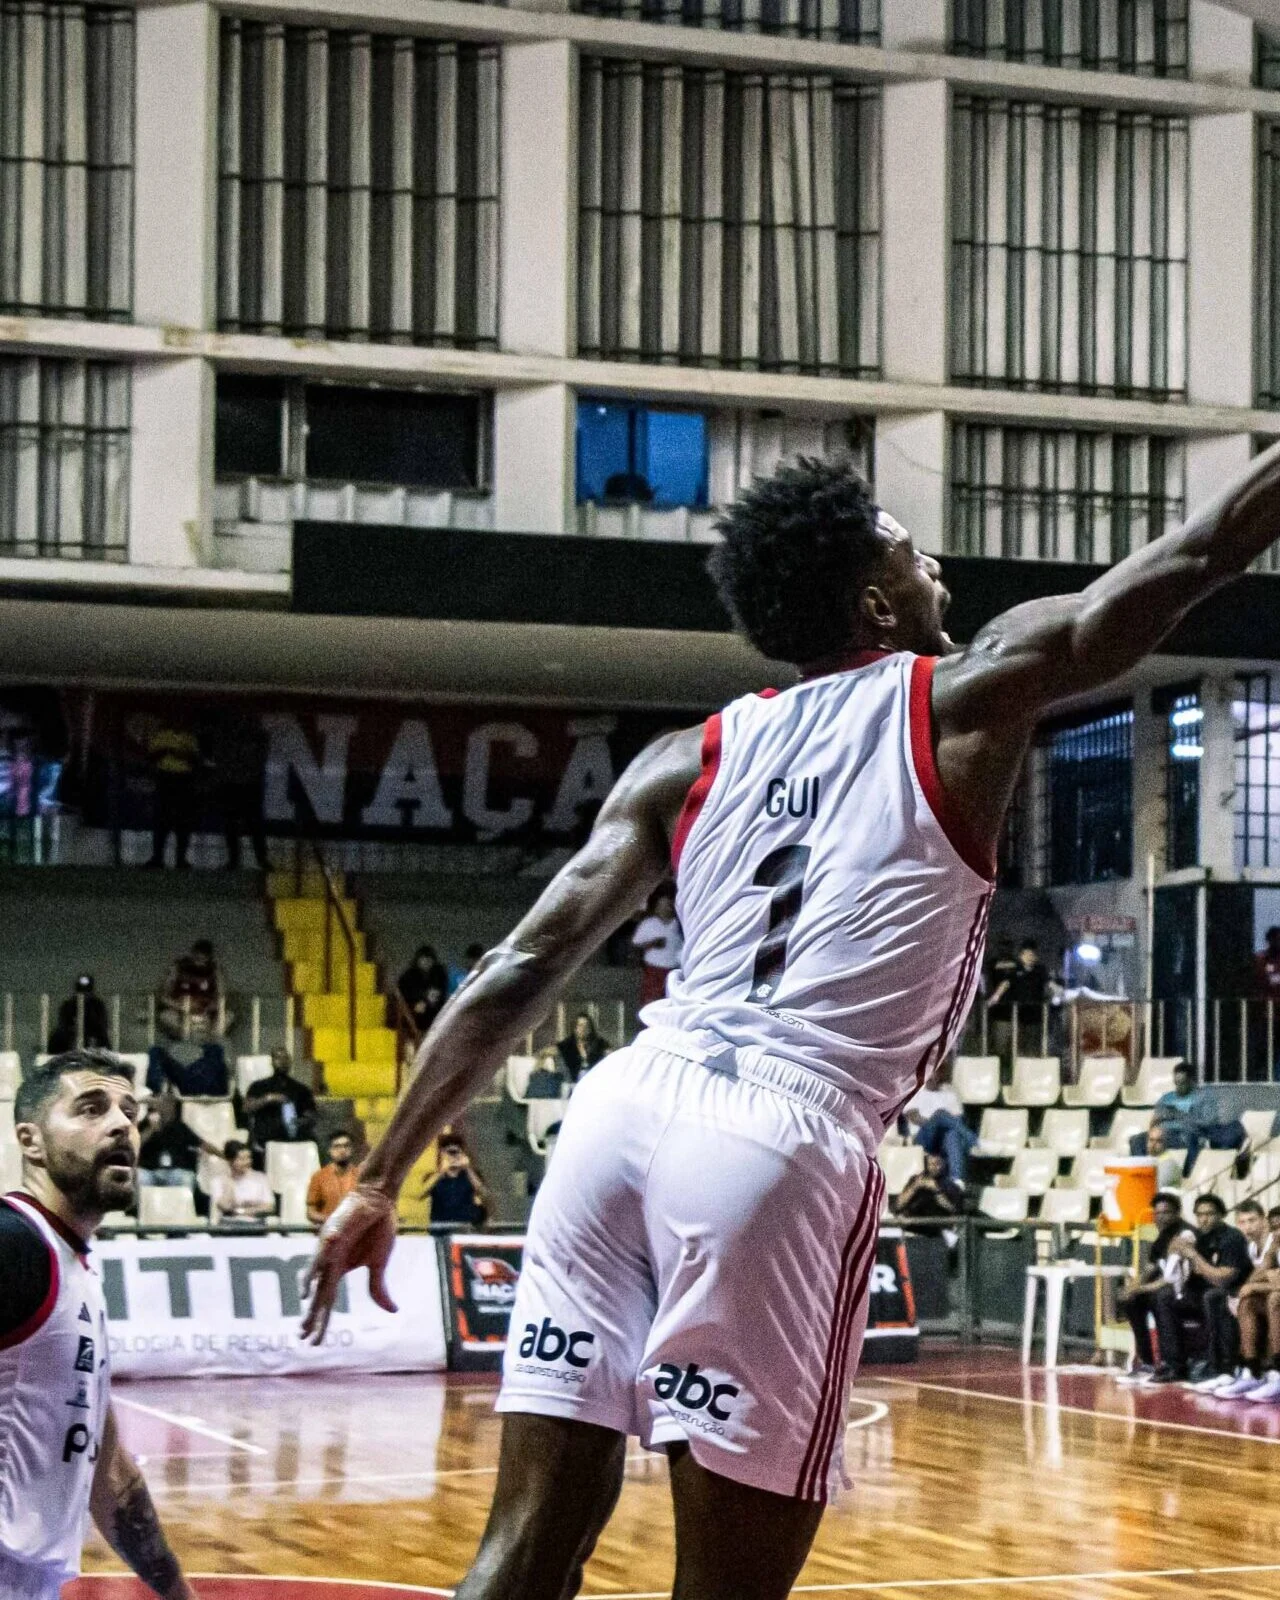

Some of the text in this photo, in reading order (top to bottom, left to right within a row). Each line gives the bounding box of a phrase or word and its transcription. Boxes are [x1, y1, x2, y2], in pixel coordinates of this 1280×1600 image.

[765, 776, 820, 820] GUI
[519, 1316, 595, 1368] abc
[654, 1362, 740, 1421] abc
